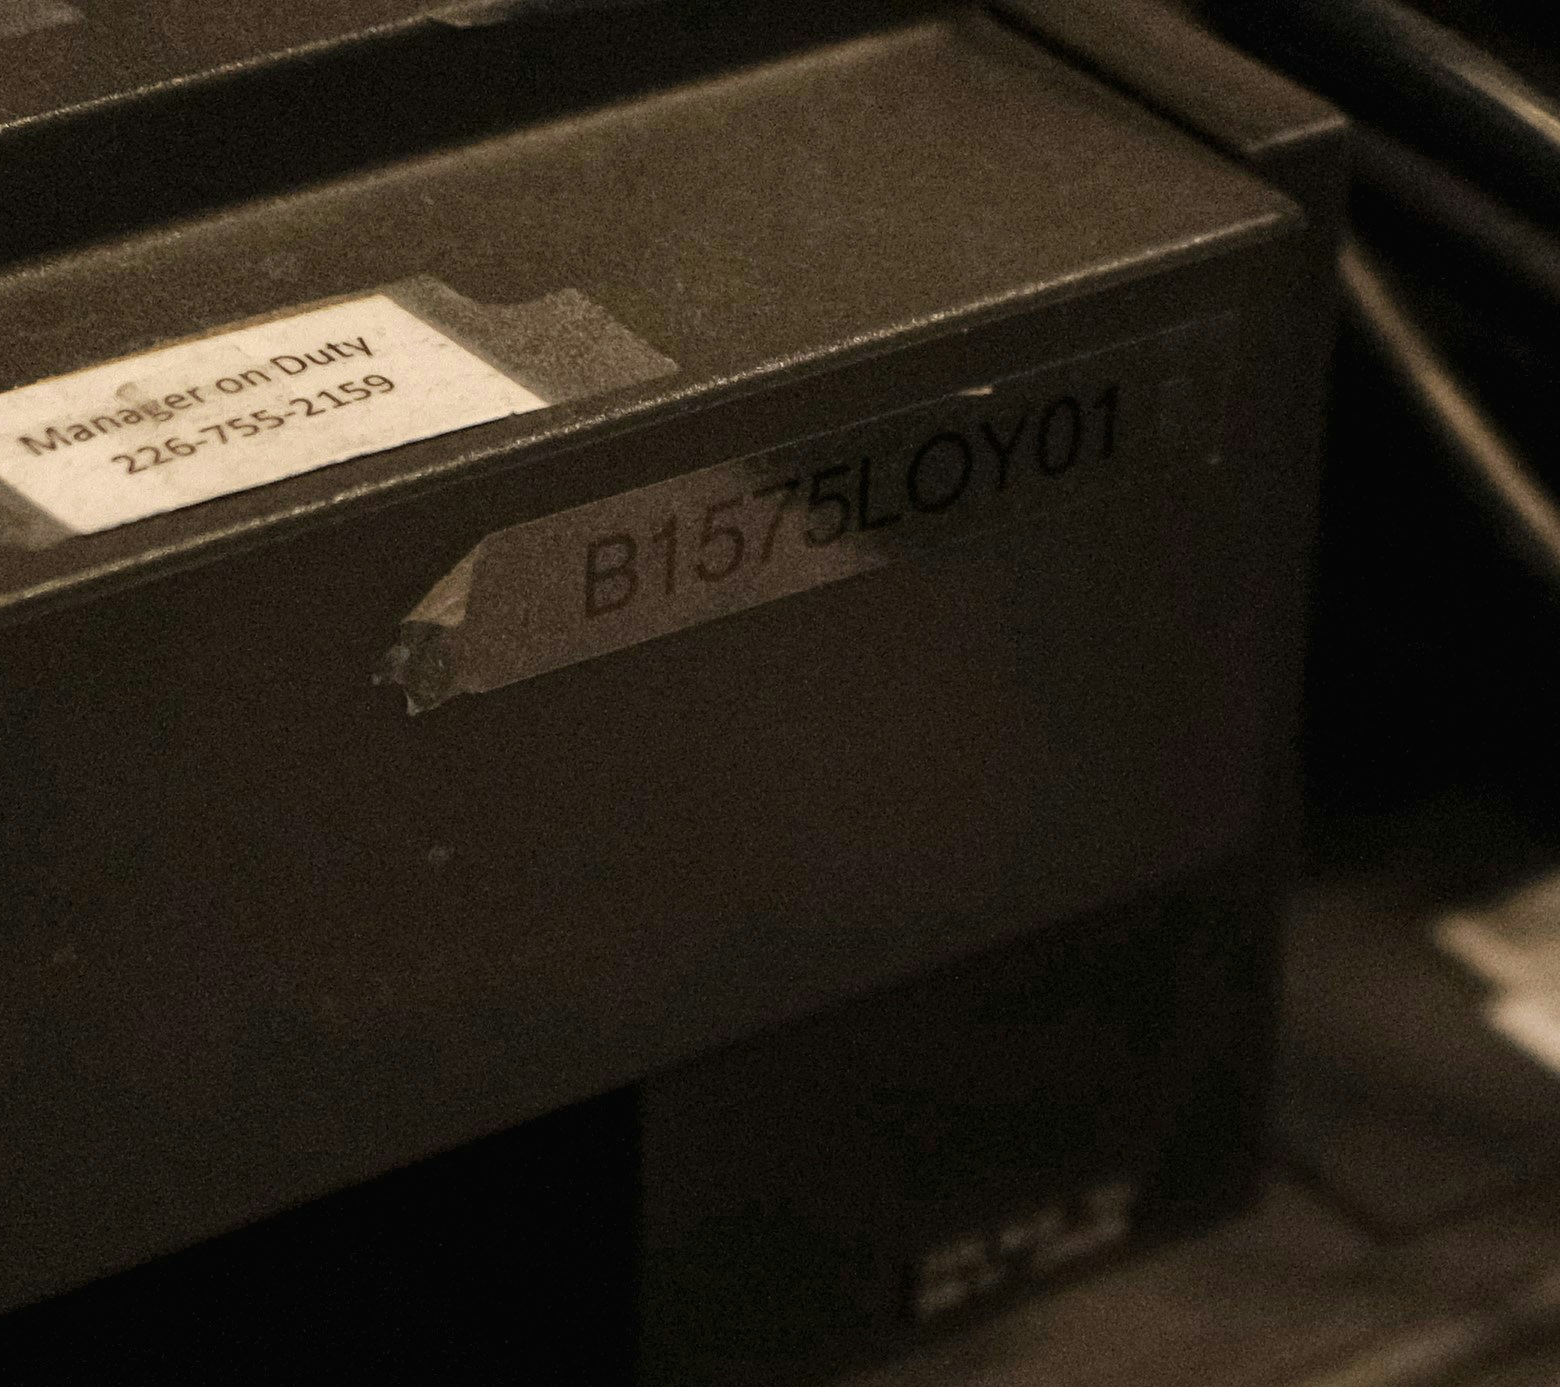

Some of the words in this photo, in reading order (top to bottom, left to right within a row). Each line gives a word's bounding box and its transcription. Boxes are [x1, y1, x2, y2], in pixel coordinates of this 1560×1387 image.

[17, 384, 205, 459] Manager
[215, 365, 273, 395] on
[275, 334, 374, 378] Duty
[111, 372, 397, 476] 226-755-2159
